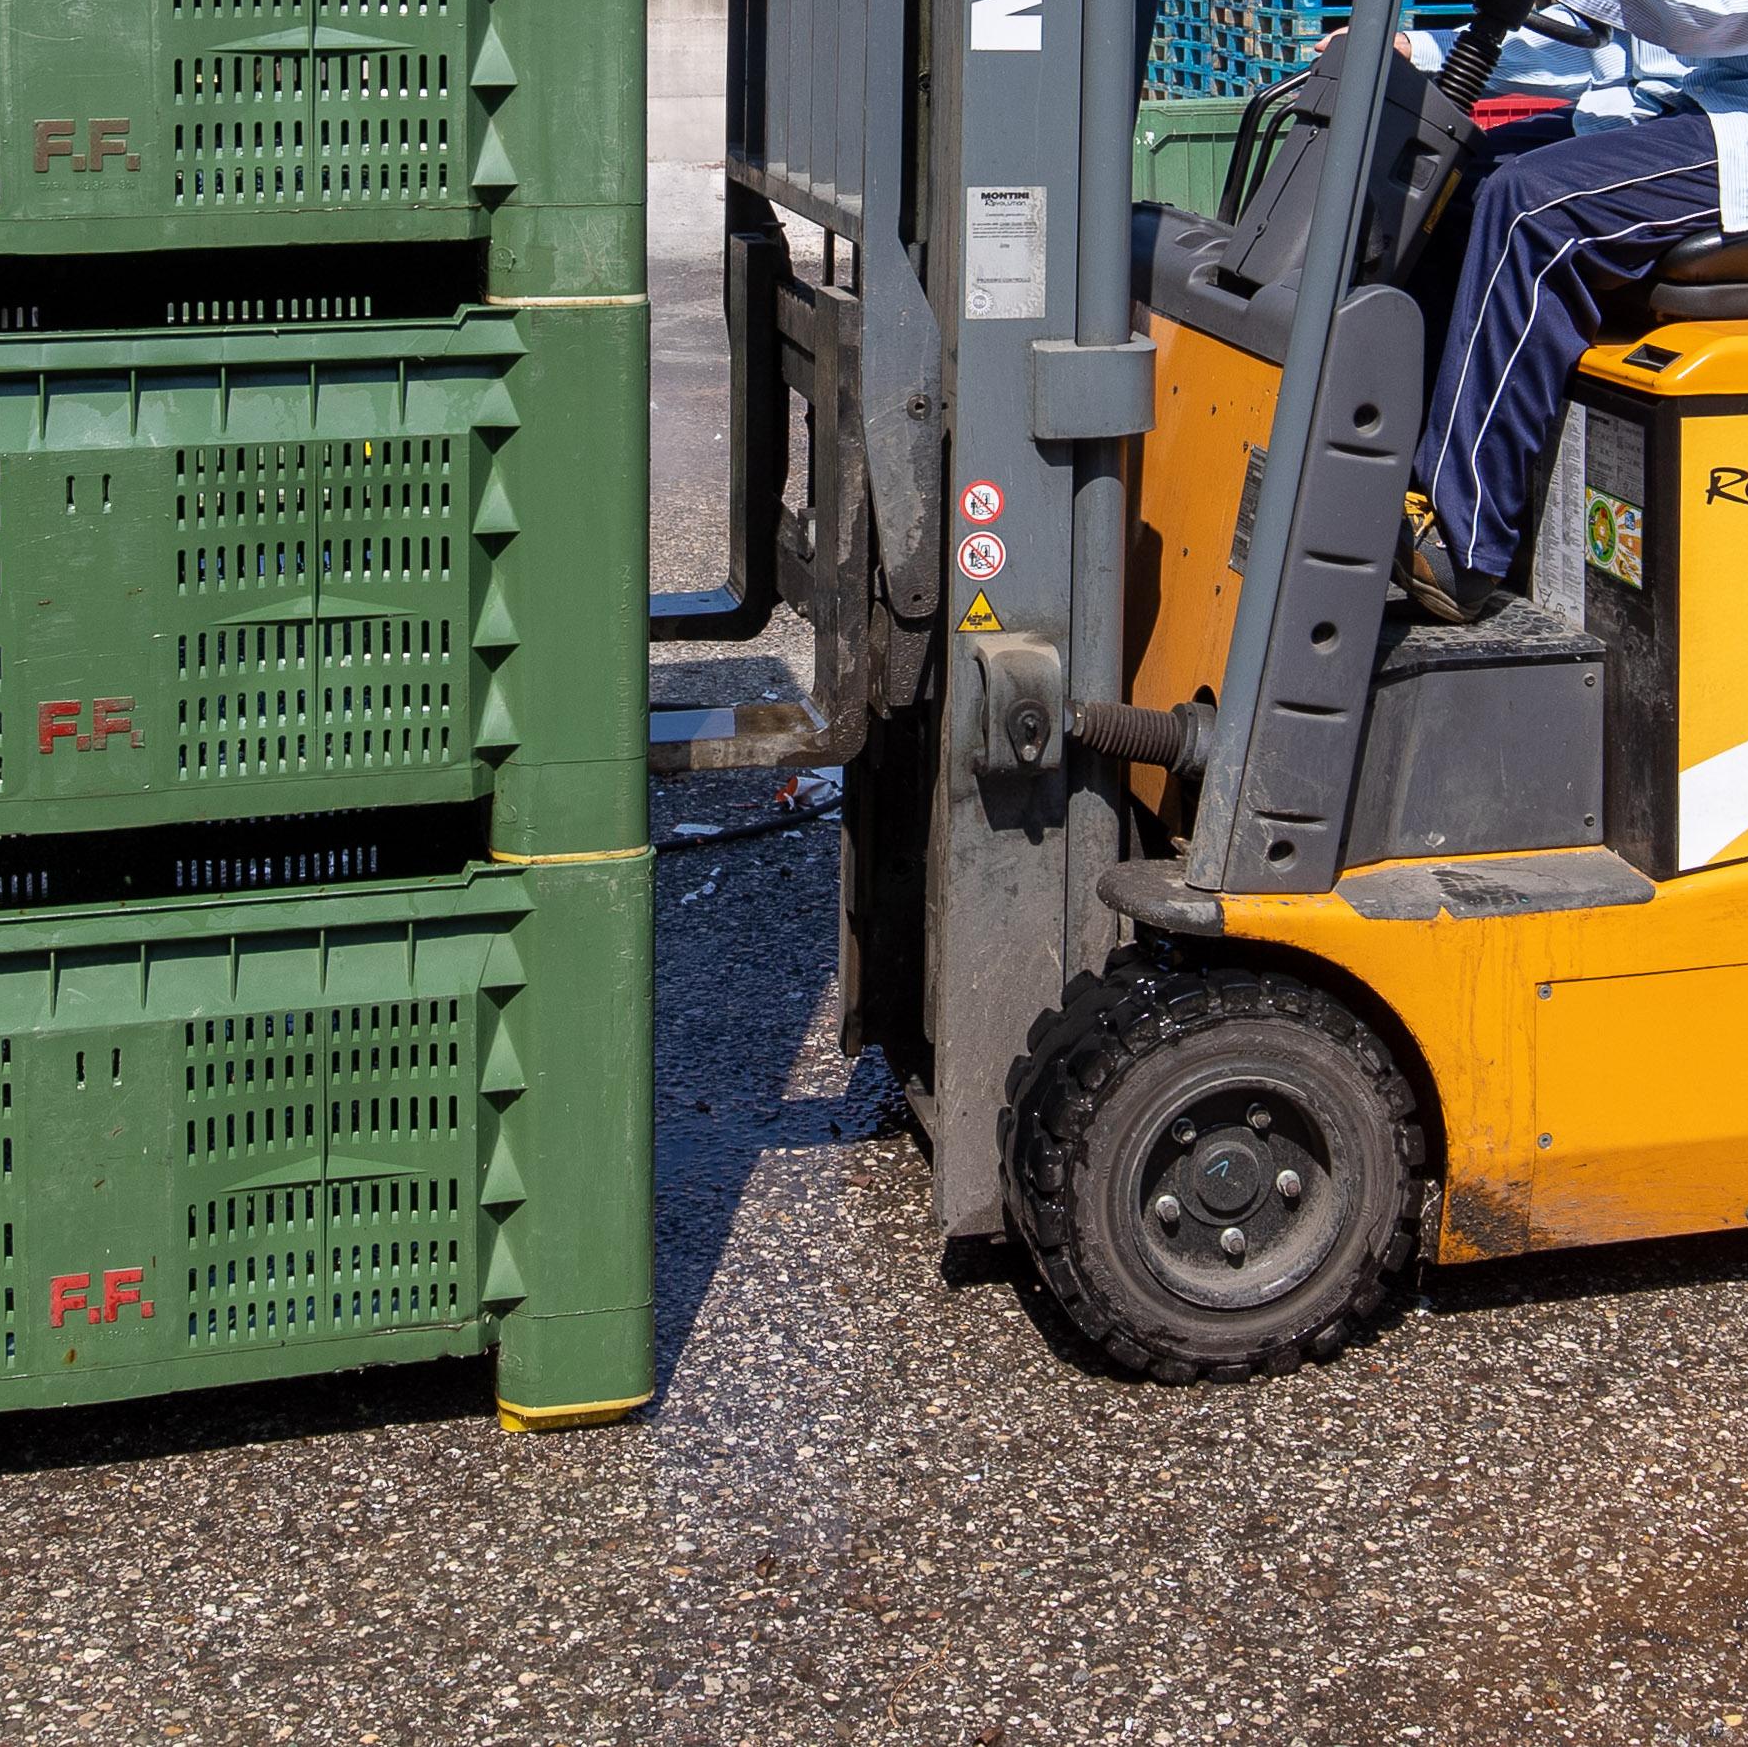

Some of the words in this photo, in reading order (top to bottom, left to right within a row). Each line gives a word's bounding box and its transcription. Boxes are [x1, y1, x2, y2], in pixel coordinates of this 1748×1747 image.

[34, 117, 141, 173] F.F.
[981, 191, 1030, 200] MONTINI
[38, 696, 146, 755] F.F.
[50, 1267, 155, 1329] F.F.
